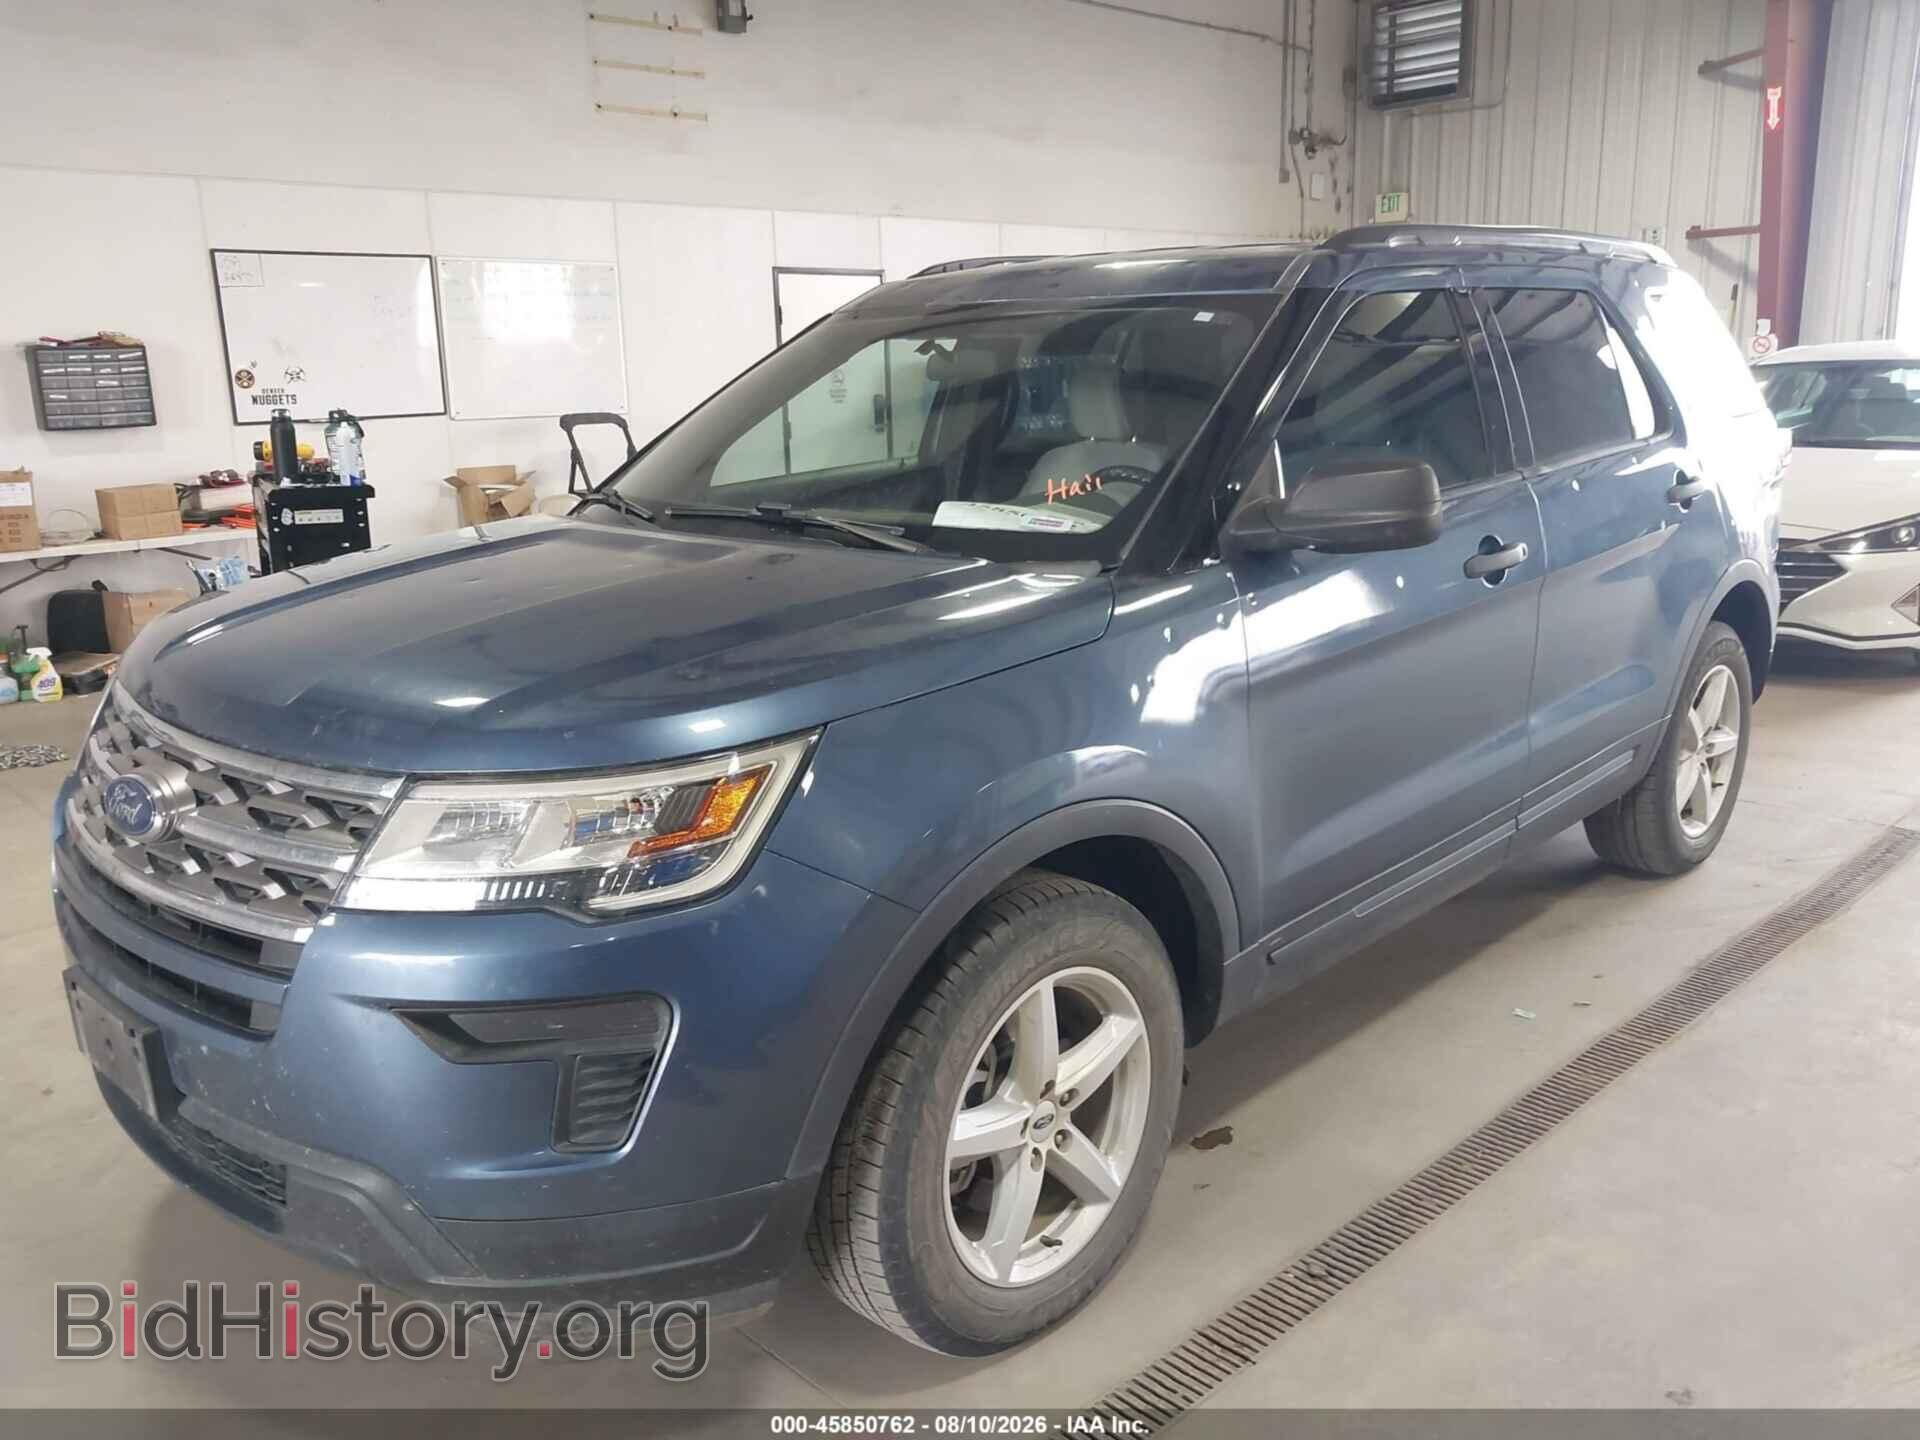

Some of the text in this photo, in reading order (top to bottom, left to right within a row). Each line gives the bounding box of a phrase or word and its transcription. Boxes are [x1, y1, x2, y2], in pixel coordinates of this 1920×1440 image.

[1380, 194, 1400, 213] EXIT
[251, 394, 297, 405] NUGGETS
[1045, 474, 1103, 505] Hail
[109, 783, 142, 825] Ford
